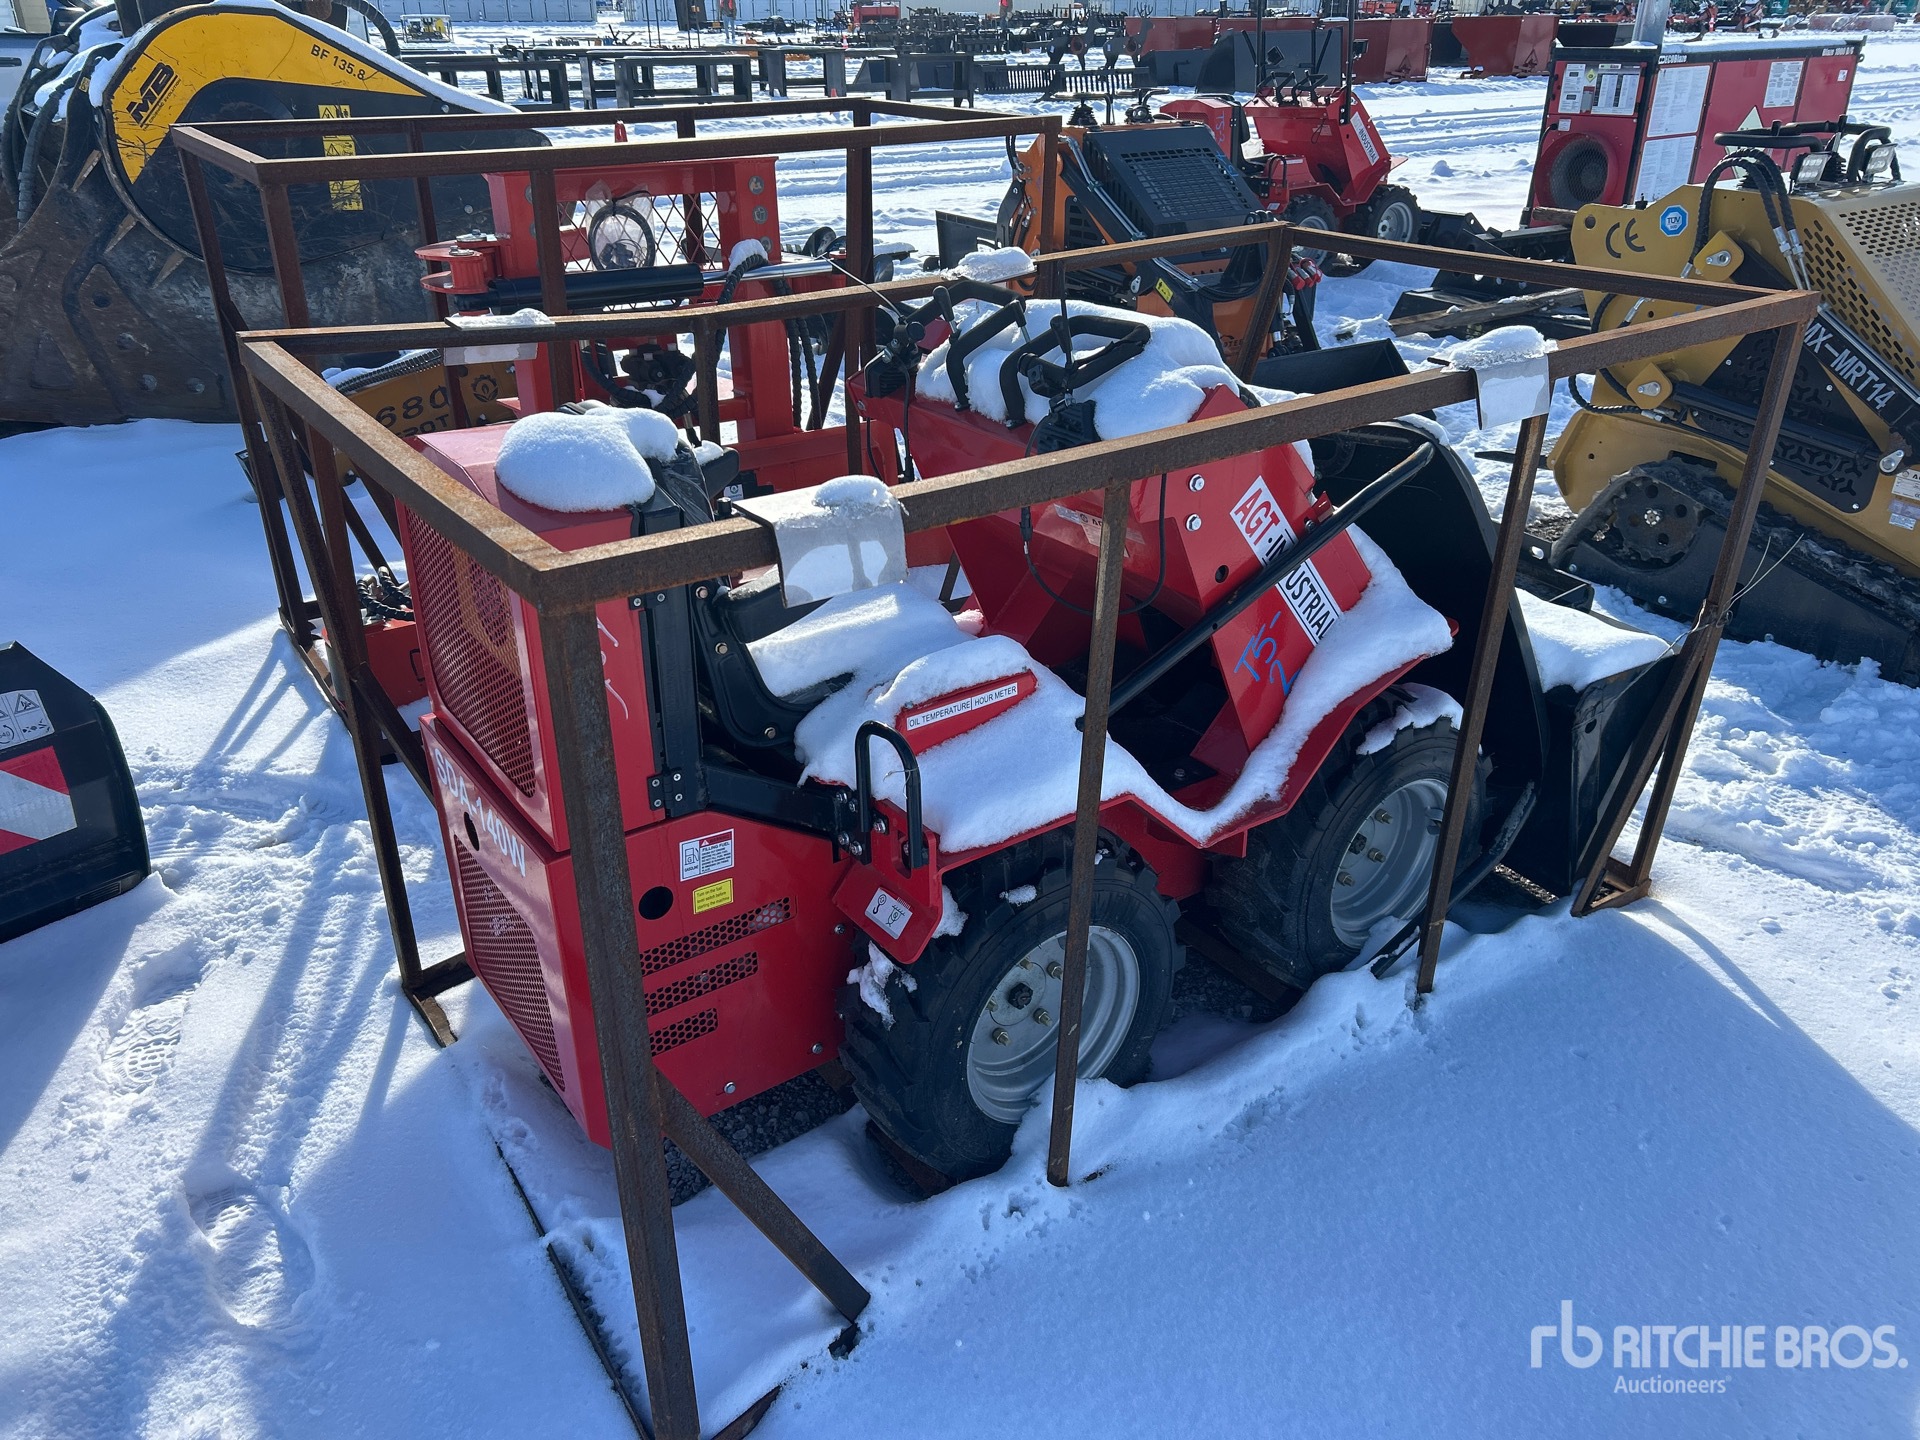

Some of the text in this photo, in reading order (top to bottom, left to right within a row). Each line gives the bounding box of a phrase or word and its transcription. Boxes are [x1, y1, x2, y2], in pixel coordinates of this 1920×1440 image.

[311, 44, 366, 80] BF 135.8
[126, 62, 175, 125] MB
[1234, 487, 1281, 546] AGT
[909, 685, 1017, 727] OIL TEMPERATURE HOUR METER
[434, 748, 526, 877] SDA-140W
